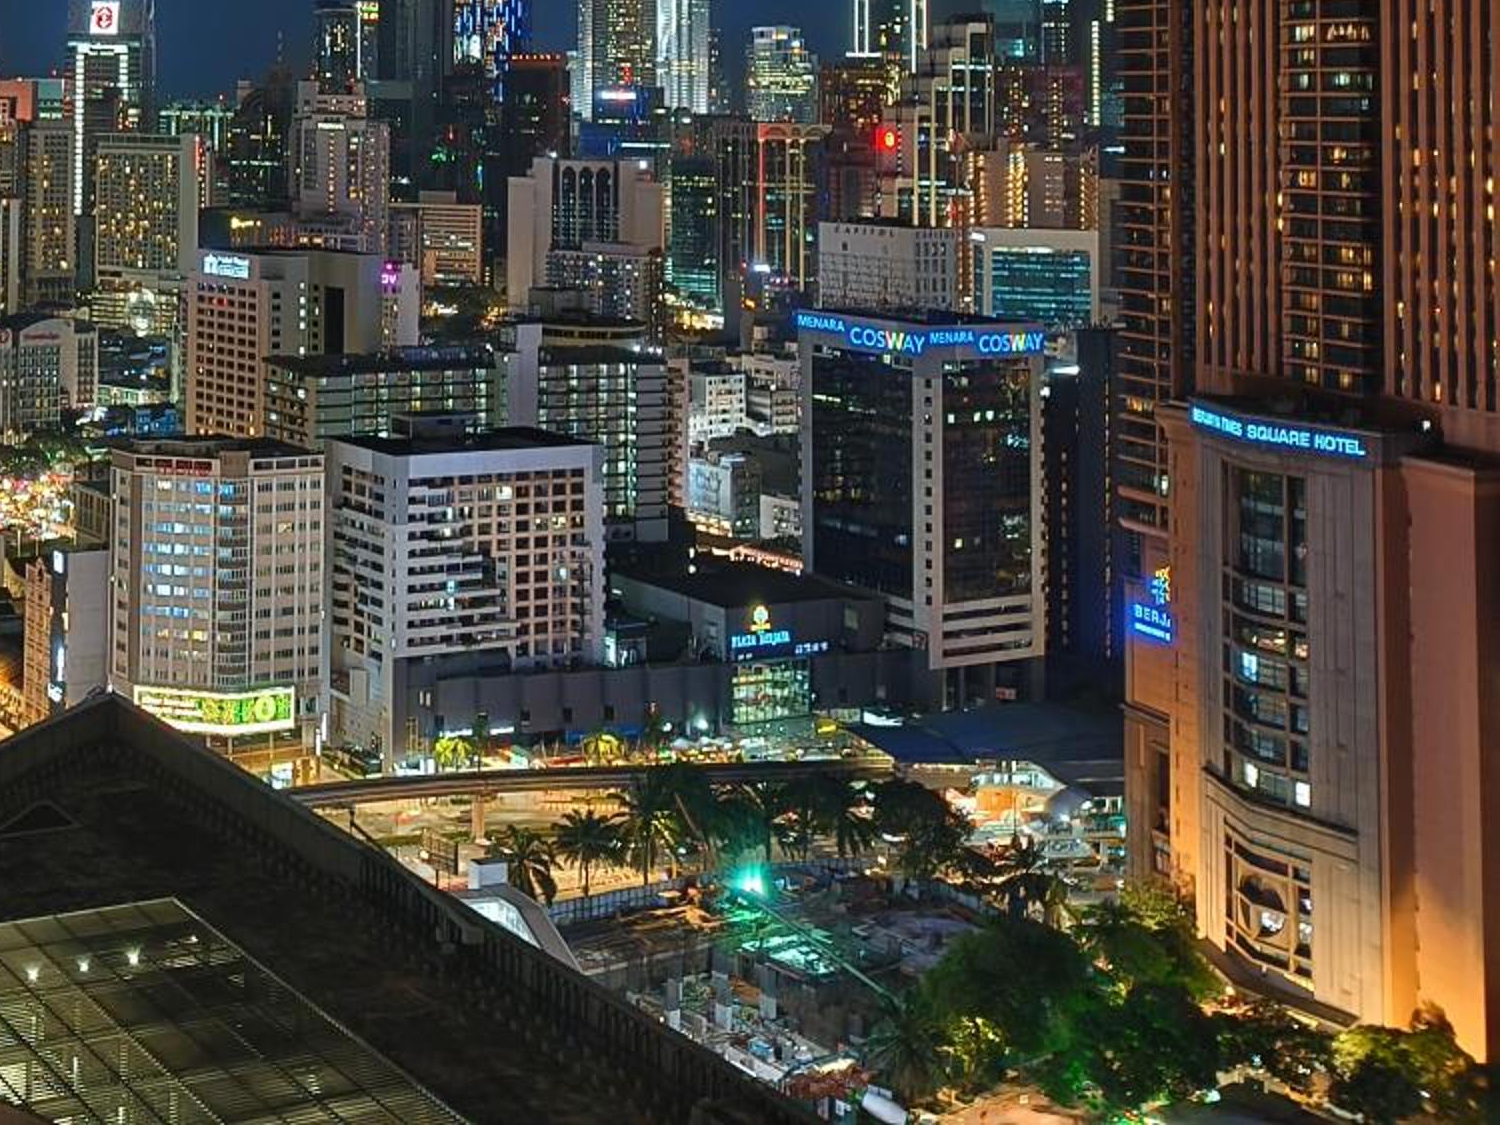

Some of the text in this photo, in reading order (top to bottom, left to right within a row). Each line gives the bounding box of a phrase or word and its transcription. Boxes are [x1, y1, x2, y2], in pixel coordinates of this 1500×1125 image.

[797, 314, 925, 355] MENARA COSWAY
[929, 330, 1043, 353] MENARA COSWAY
[1246, 424, 1311, 448] SQUARE
[1313, 433, 1366, 456] HOTEL
[1134, 604, 1171, 628] BERJ
